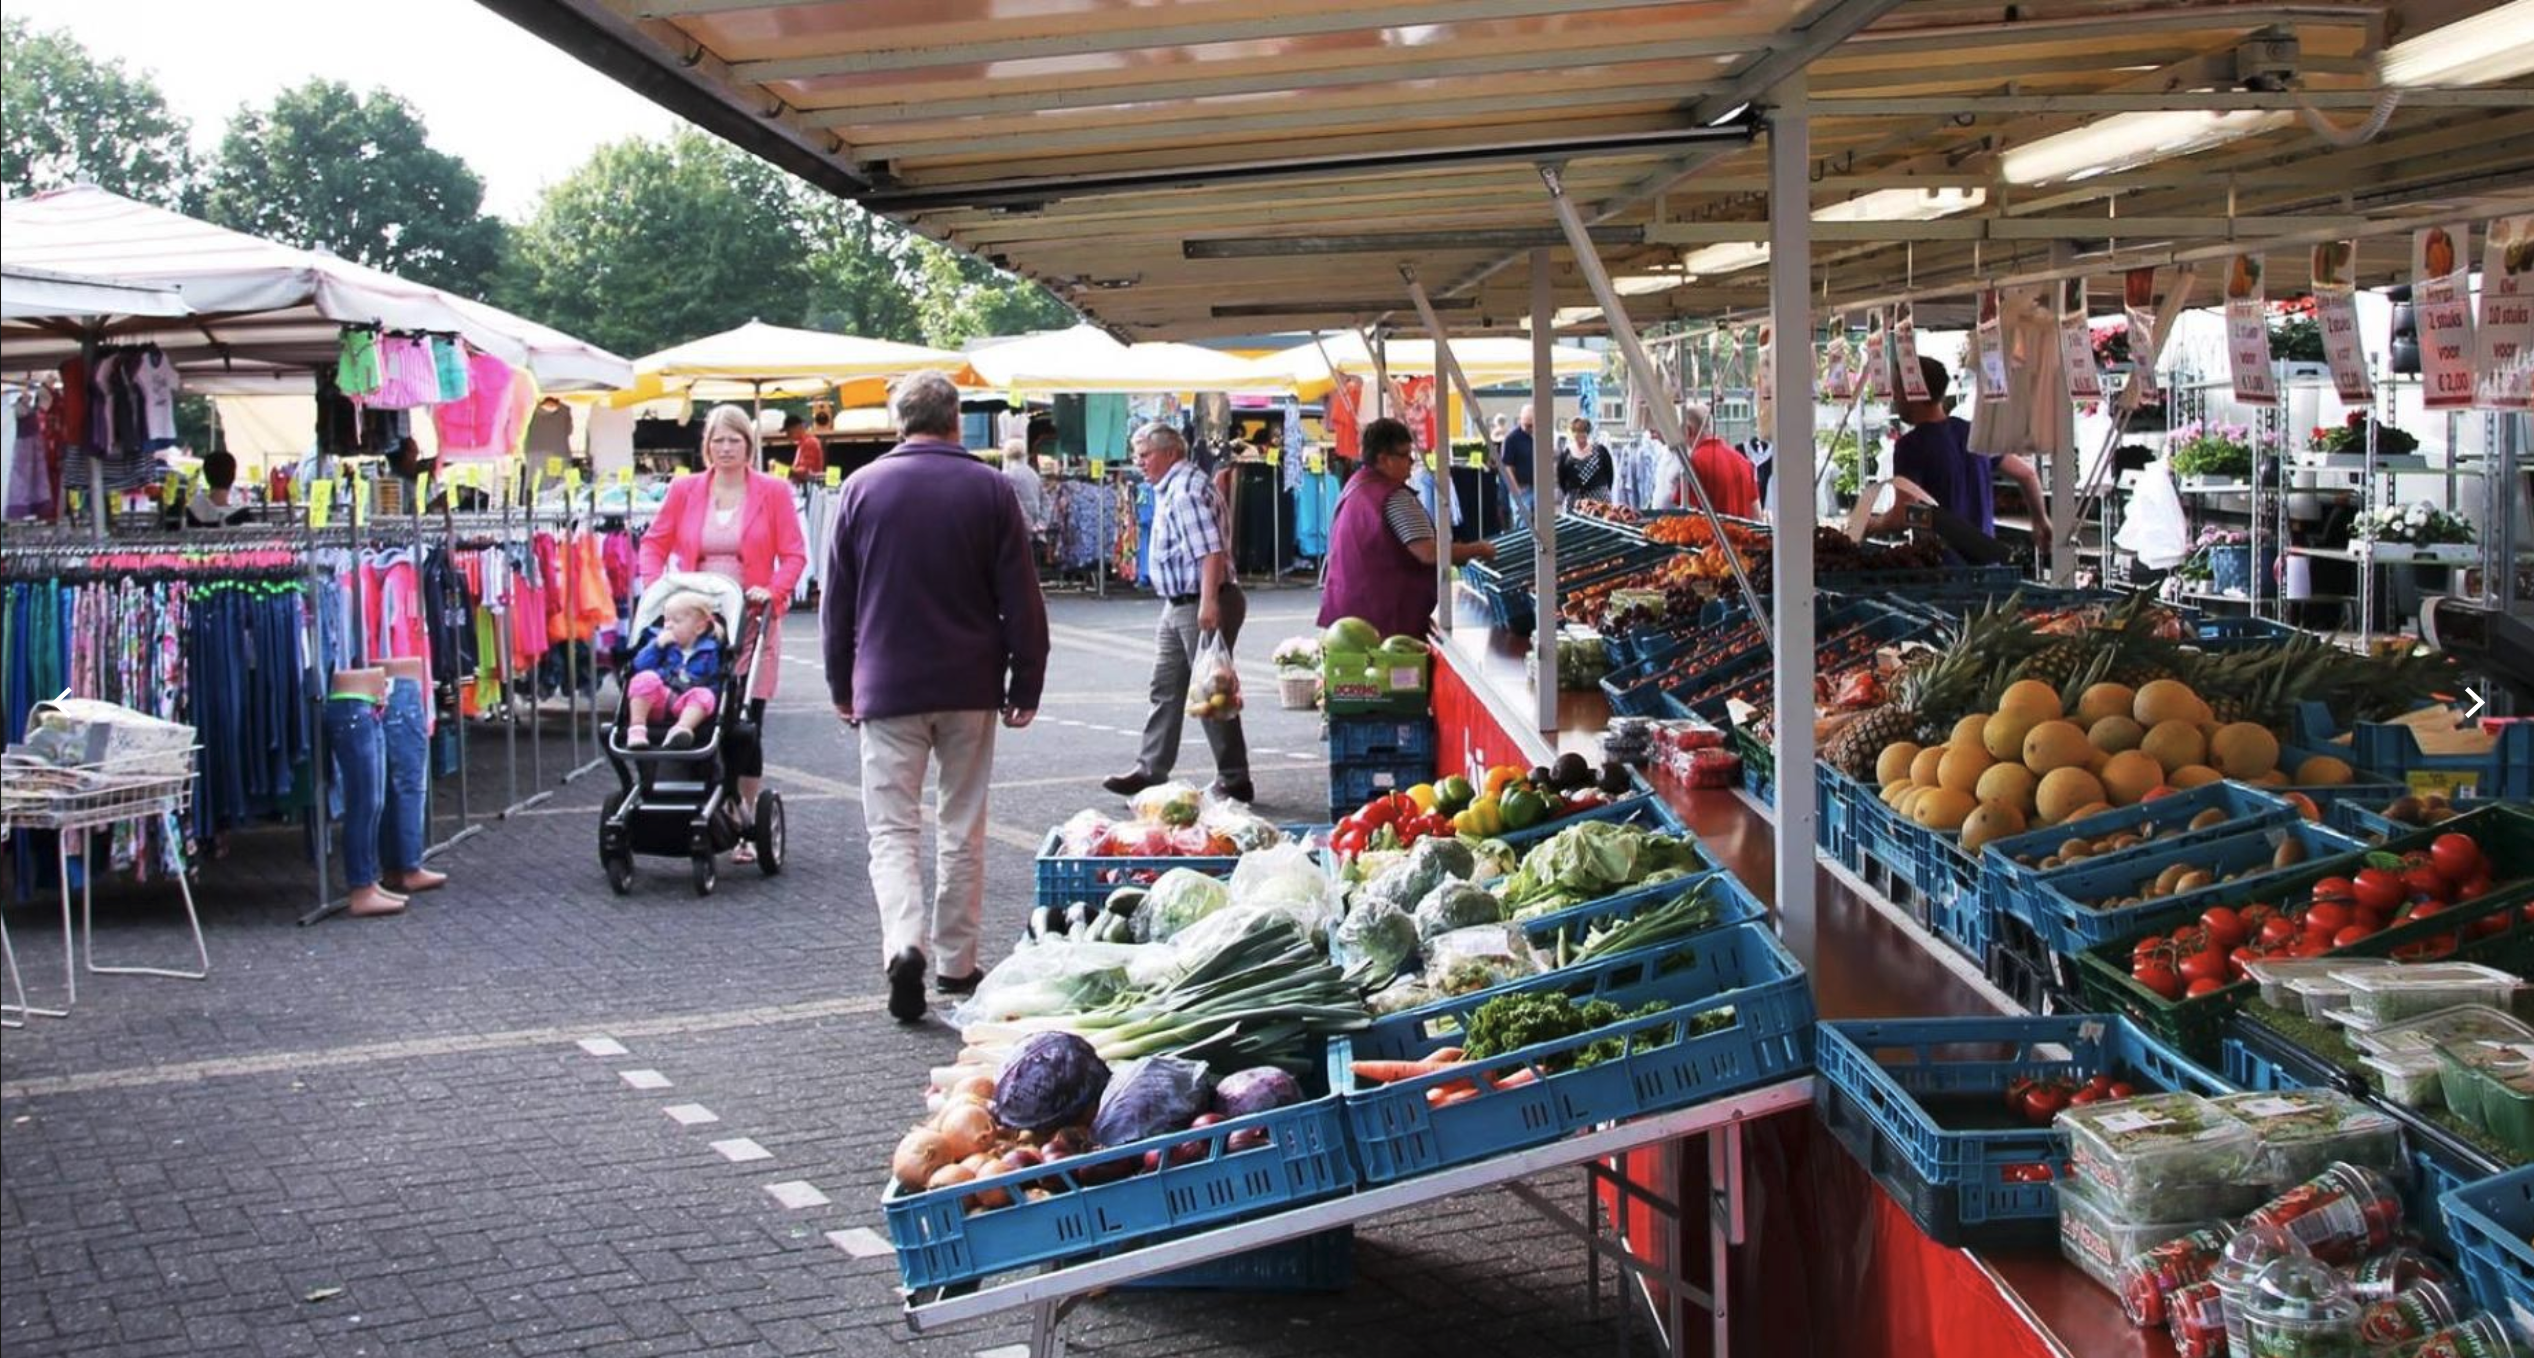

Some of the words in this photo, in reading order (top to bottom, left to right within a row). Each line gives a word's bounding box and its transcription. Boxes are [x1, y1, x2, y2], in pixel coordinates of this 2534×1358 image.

[2428, 312, 2436, 330] 2
[2437, 310, 2463, 329] stuks
[2488, 305, 2501, 325] 10
[2502, 305, 2529, 325] stuks
[2438, 344, 2460, 361] voor
[2493, 341, 2518, 359] voor
[2438, 372, 2445, 392] €
[2446, 371, 2469, 392] 2,00
